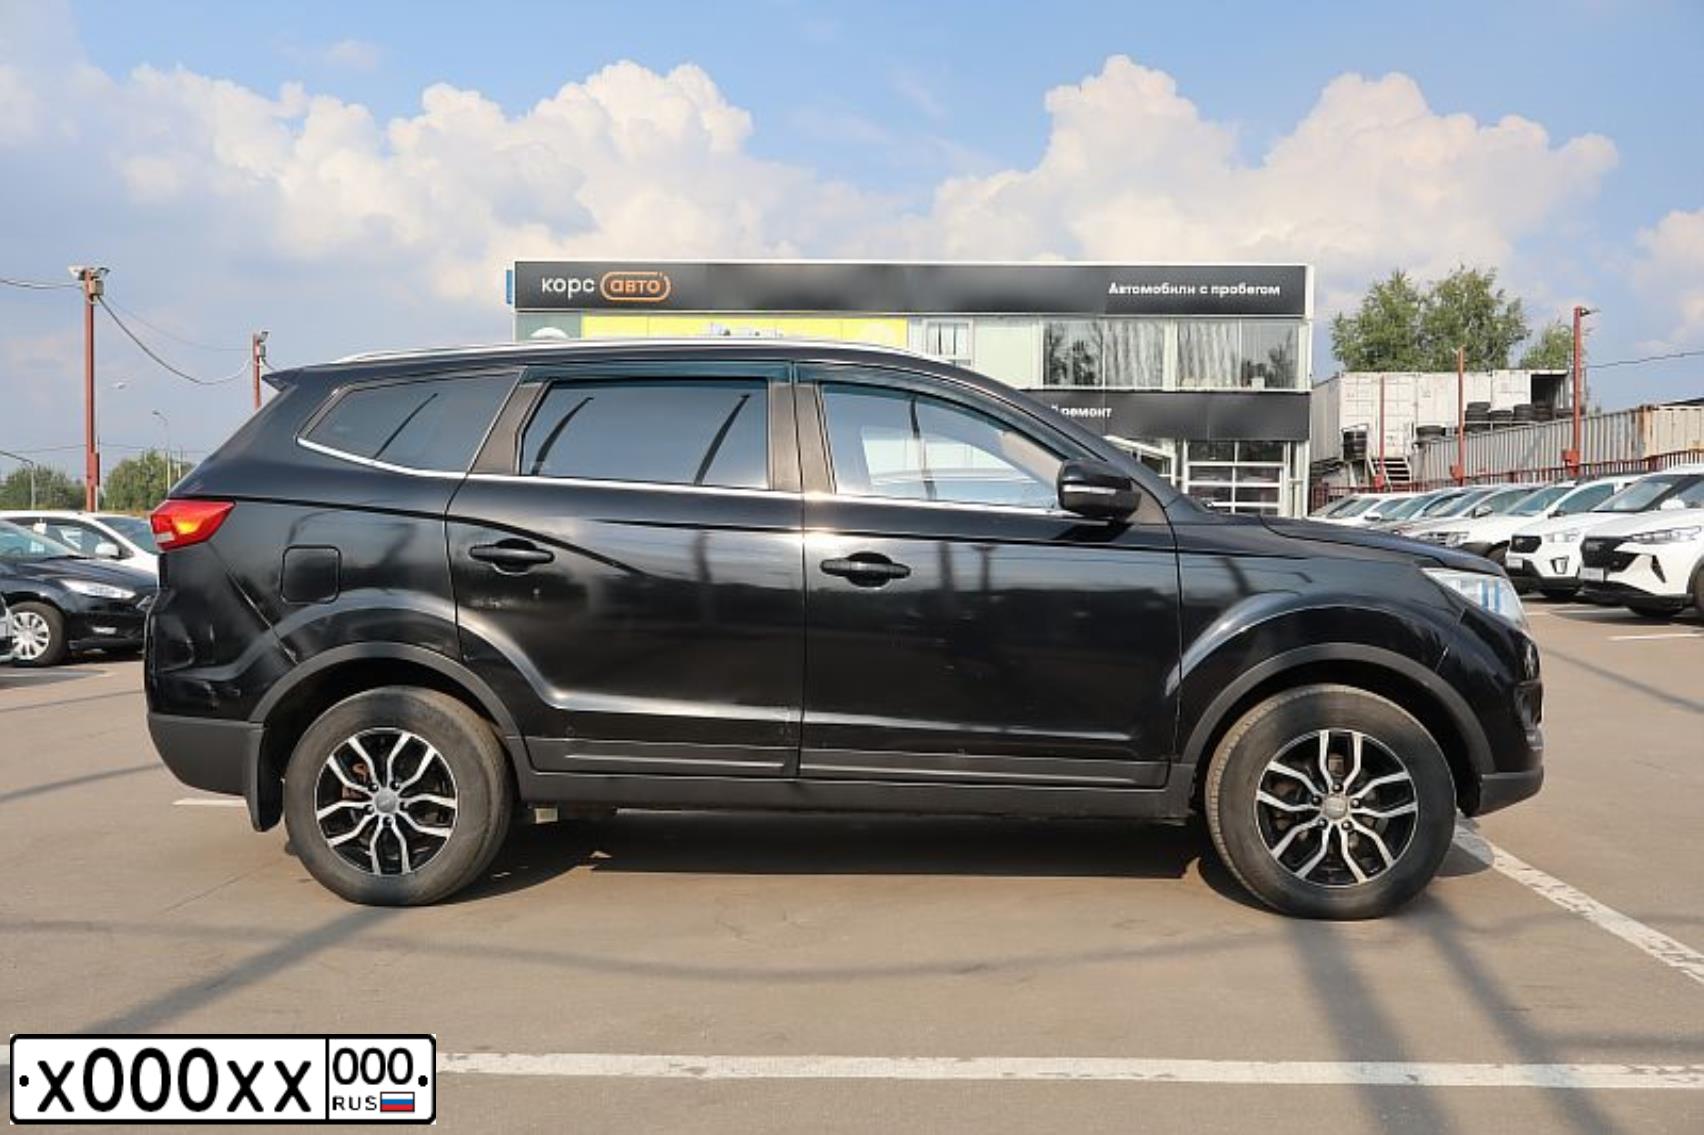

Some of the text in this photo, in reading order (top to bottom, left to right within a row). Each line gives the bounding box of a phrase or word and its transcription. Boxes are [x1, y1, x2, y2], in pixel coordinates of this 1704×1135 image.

[542, 278, 660, 299] корс авто
[1108, 282, 1281, 298] Автомобили с пробегом
